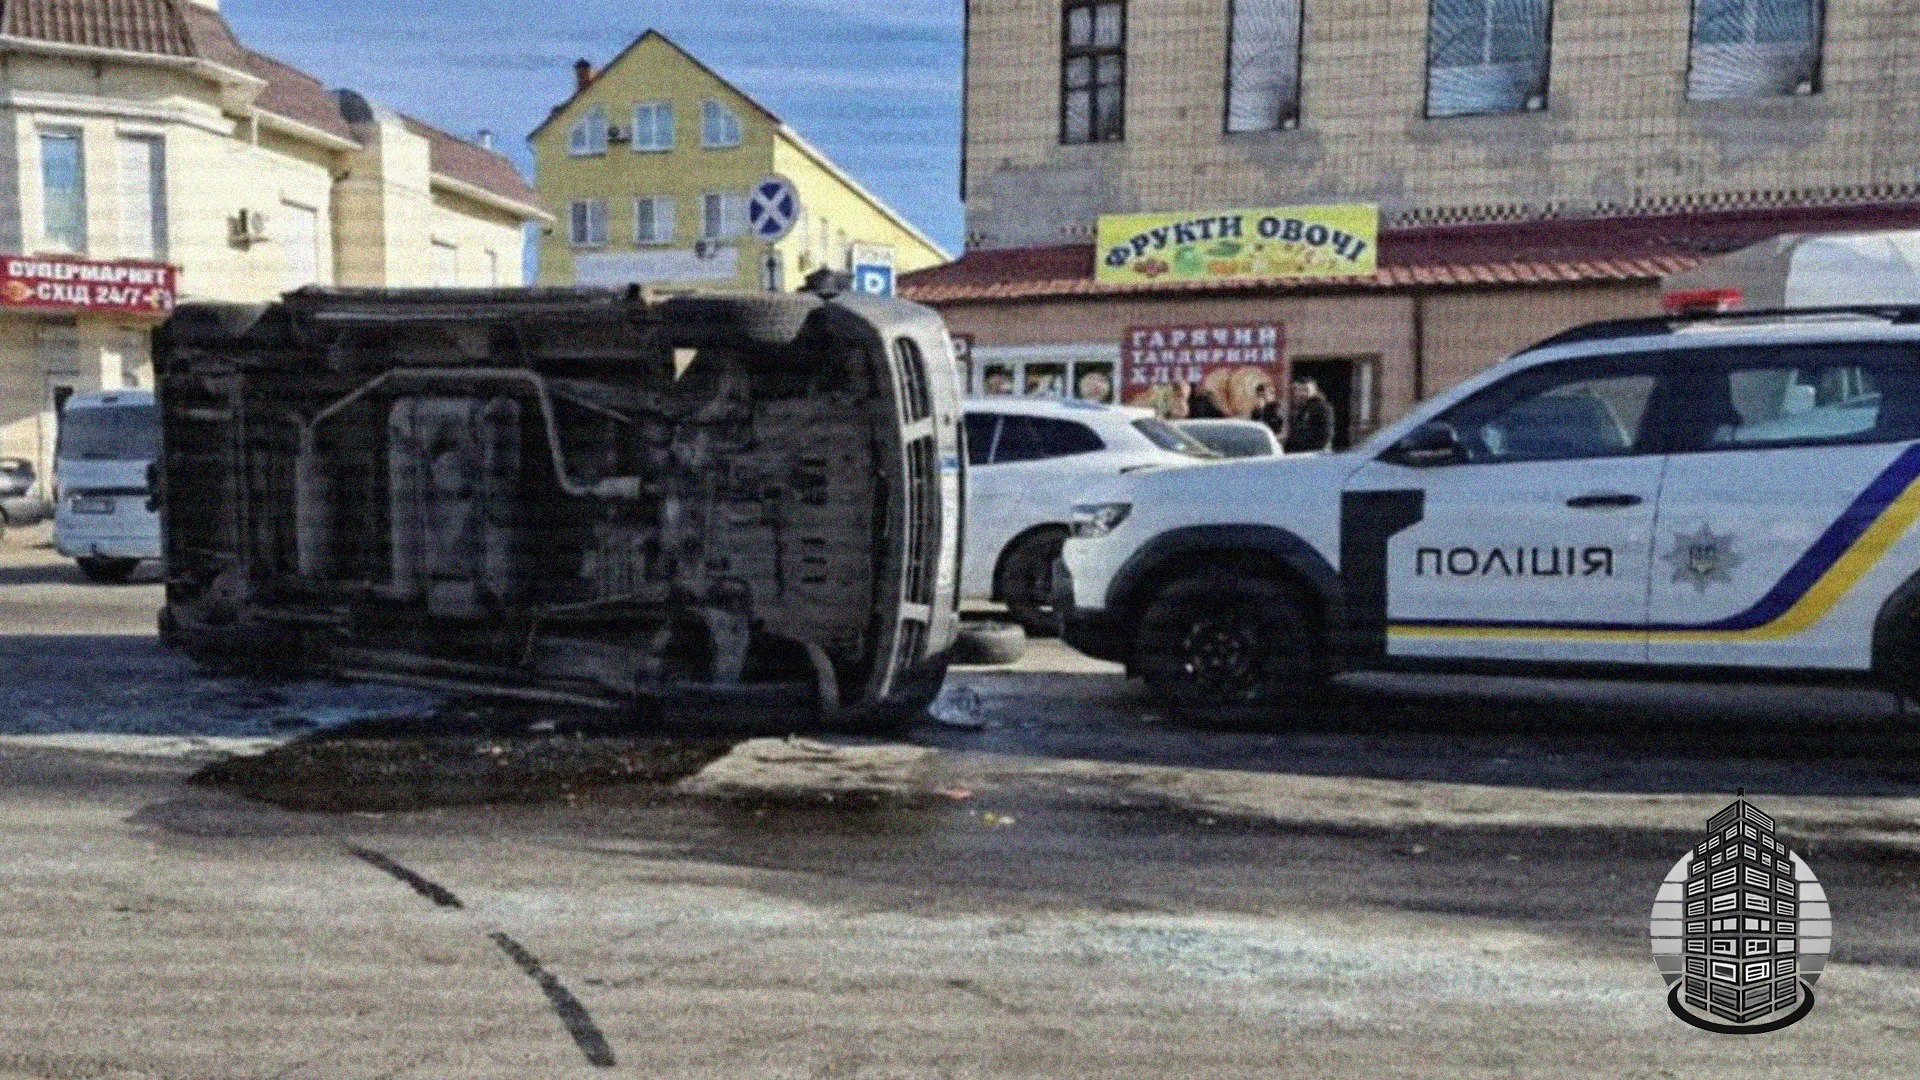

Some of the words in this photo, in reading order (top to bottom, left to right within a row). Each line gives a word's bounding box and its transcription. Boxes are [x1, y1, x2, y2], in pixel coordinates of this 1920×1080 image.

[1105, 215, 1243, 267] ФРУКТИ
[1257, 216, 1366, 262] ОВОЧІ
[8, 261, 167, 285] СУПЕРМАРКЕТ
[37, 282, 90, 305] СХІД
[95, 285, 142, 305] 24/7
[1132, 328, 1278, 347] ГАРЯЧИЙ
[1131, 366, 1203, 384] ХЛІБ
[1415, 547, 1614, 577] ПОЛІЦІЯ
